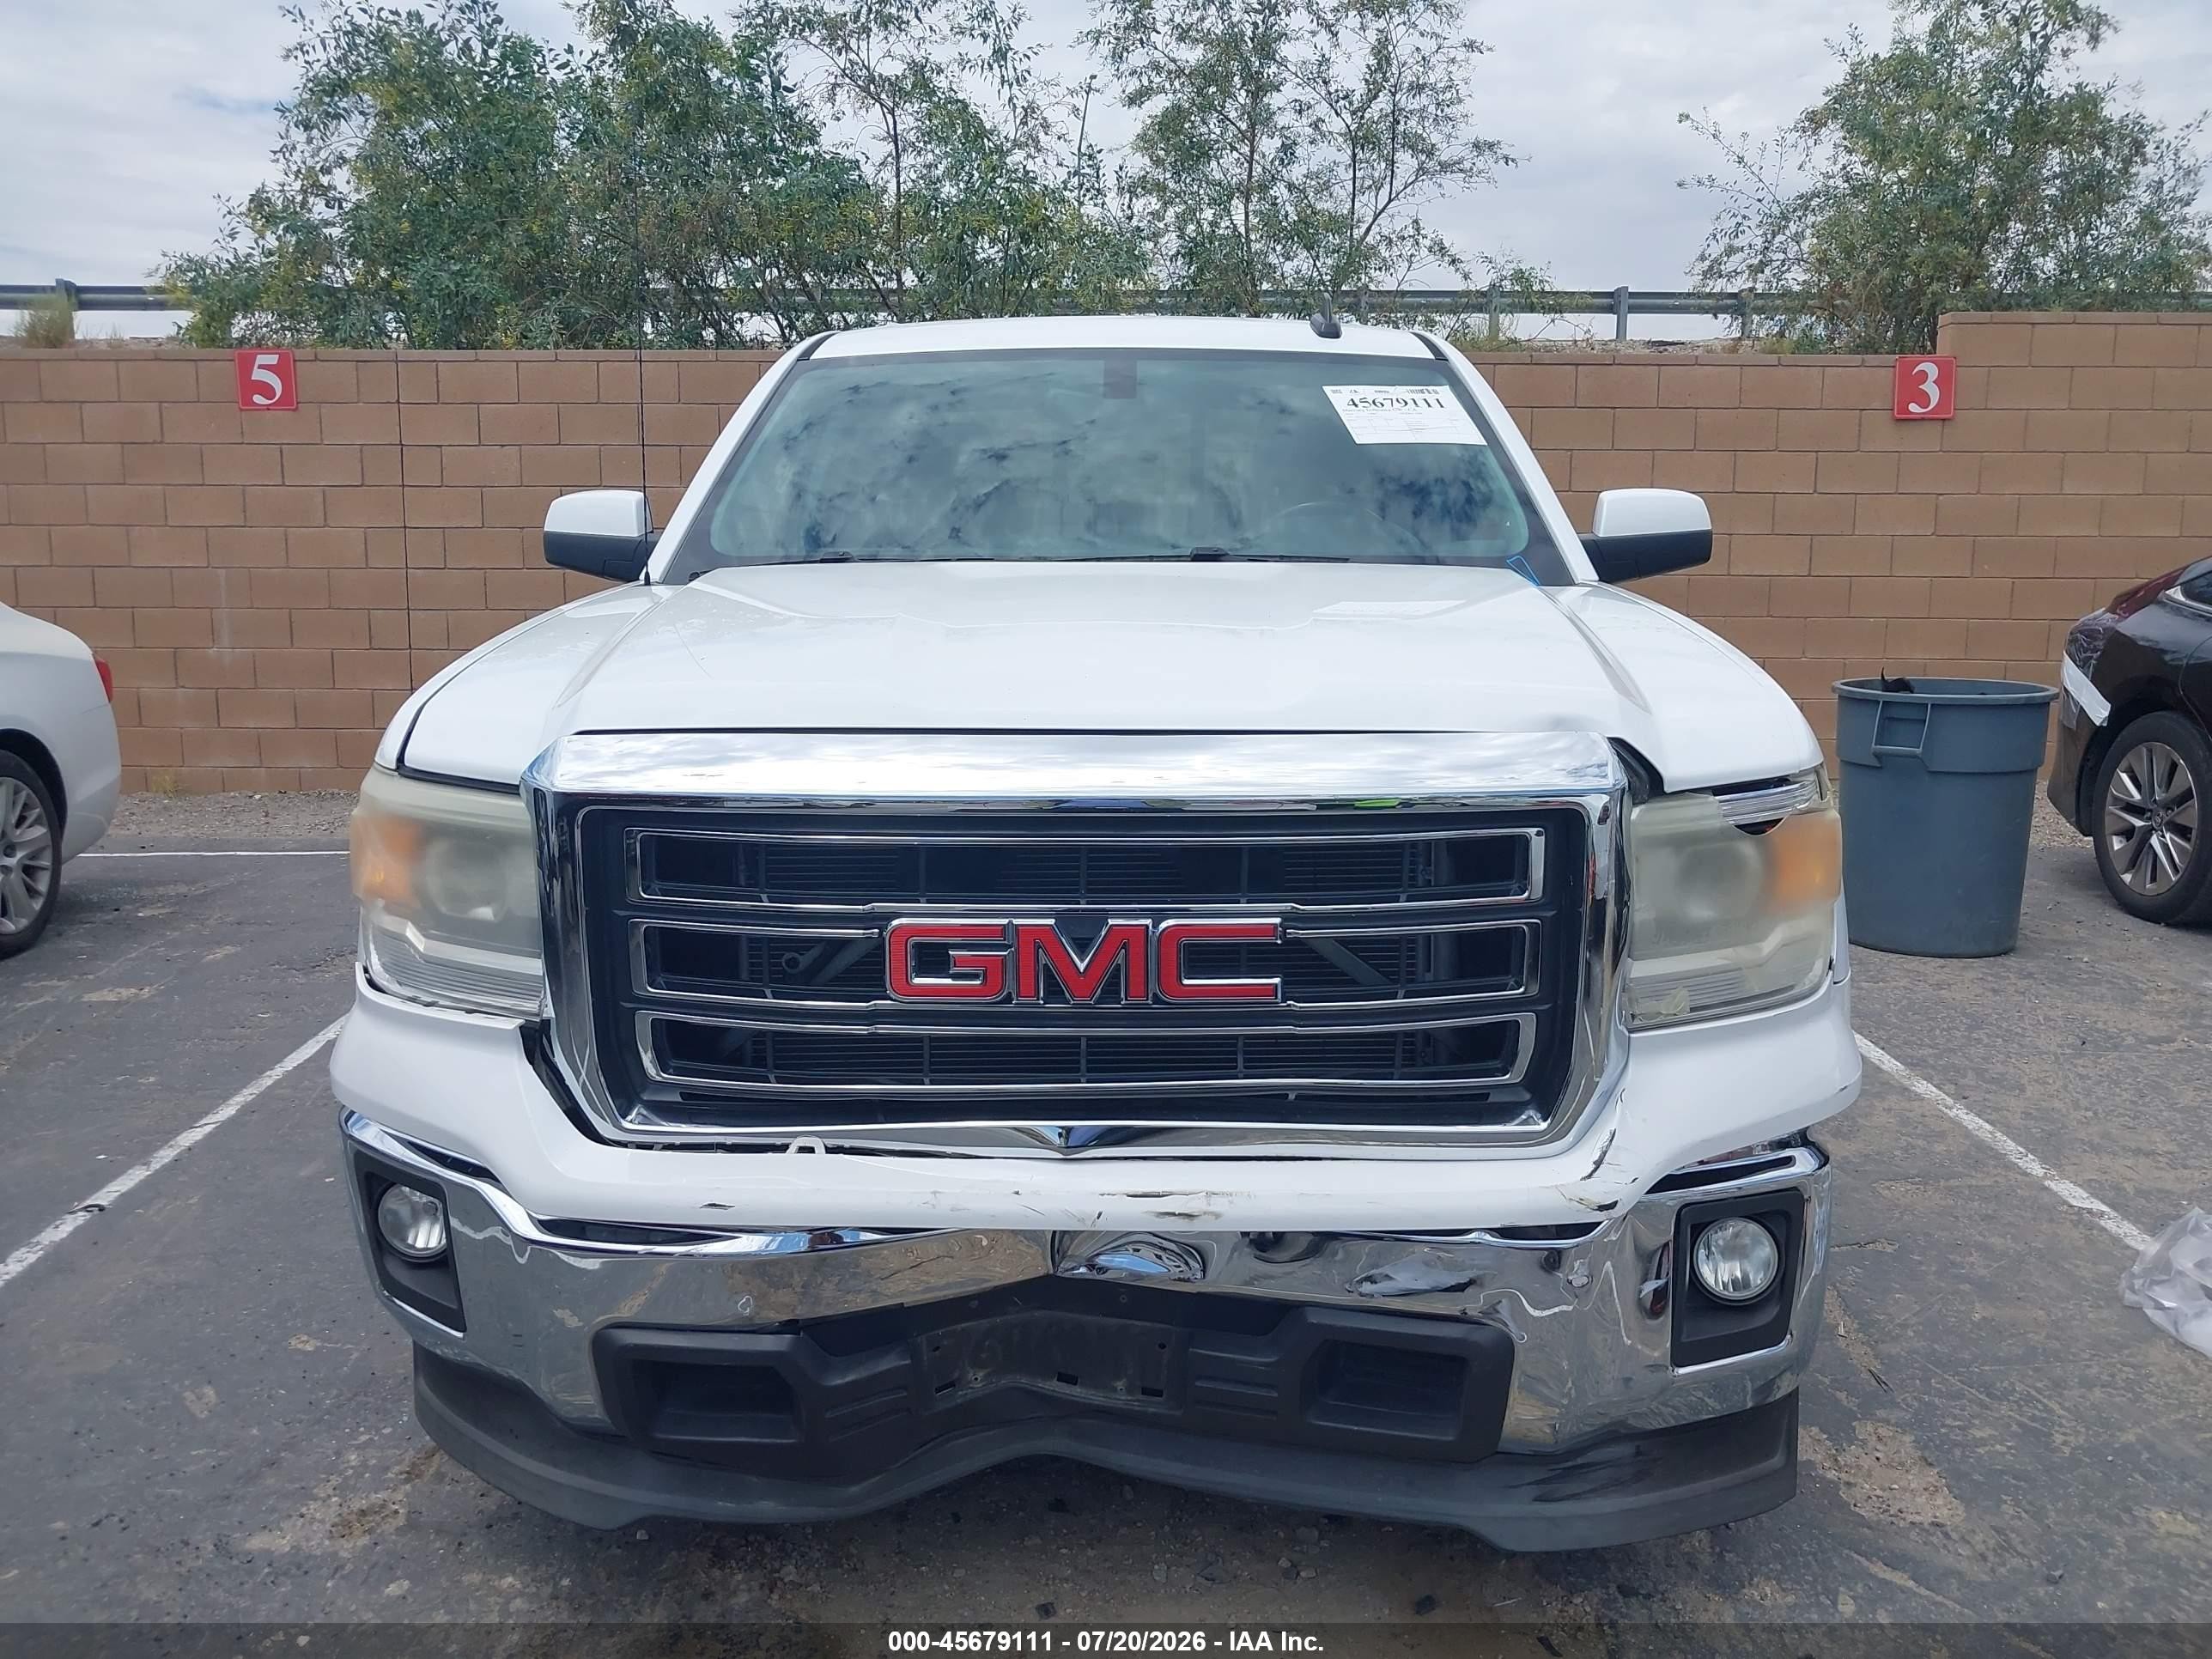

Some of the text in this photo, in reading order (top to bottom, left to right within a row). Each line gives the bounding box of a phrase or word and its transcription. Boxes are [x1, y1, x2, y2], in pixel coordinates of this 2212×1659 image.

[251, 354, 283, 405] 5
[1346, 397, 1444, 408] 45679111
[1908, 362, 1940, 413] 3
[885, 917, 1283, 1005] GMC
